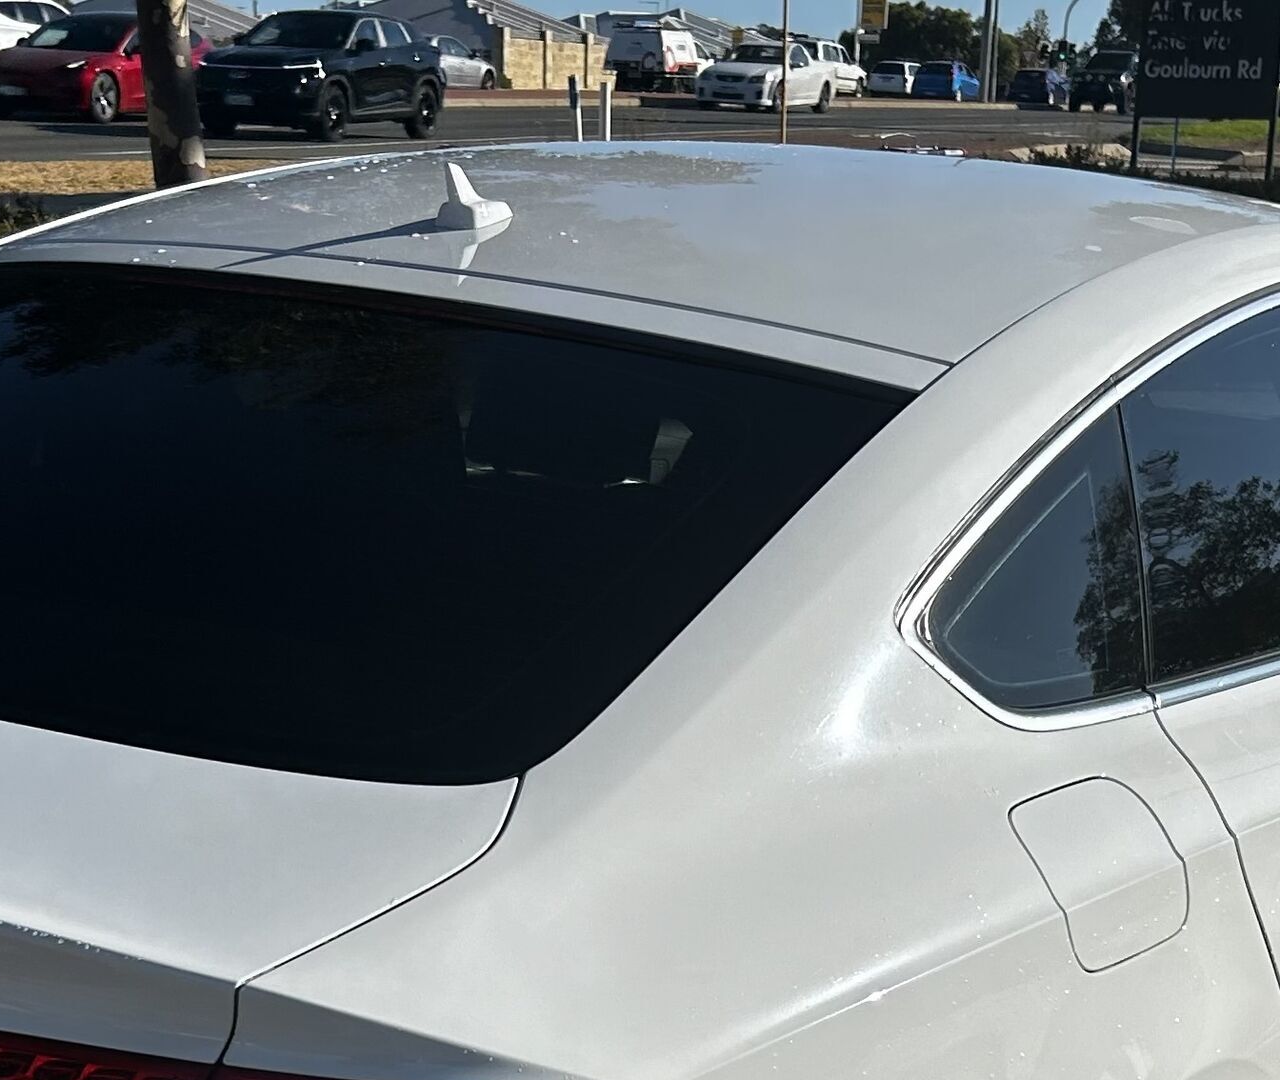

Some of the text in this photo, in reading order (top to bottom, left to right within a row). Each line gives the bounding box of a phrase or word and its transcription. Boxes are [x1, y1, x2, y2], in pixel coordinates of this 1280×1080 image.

[1148, 0, 1243, 22] Al Tucks
[1146, 29, 1190, 50] Ente
[1144, 56, 1263, 80] Goulburn Rd
